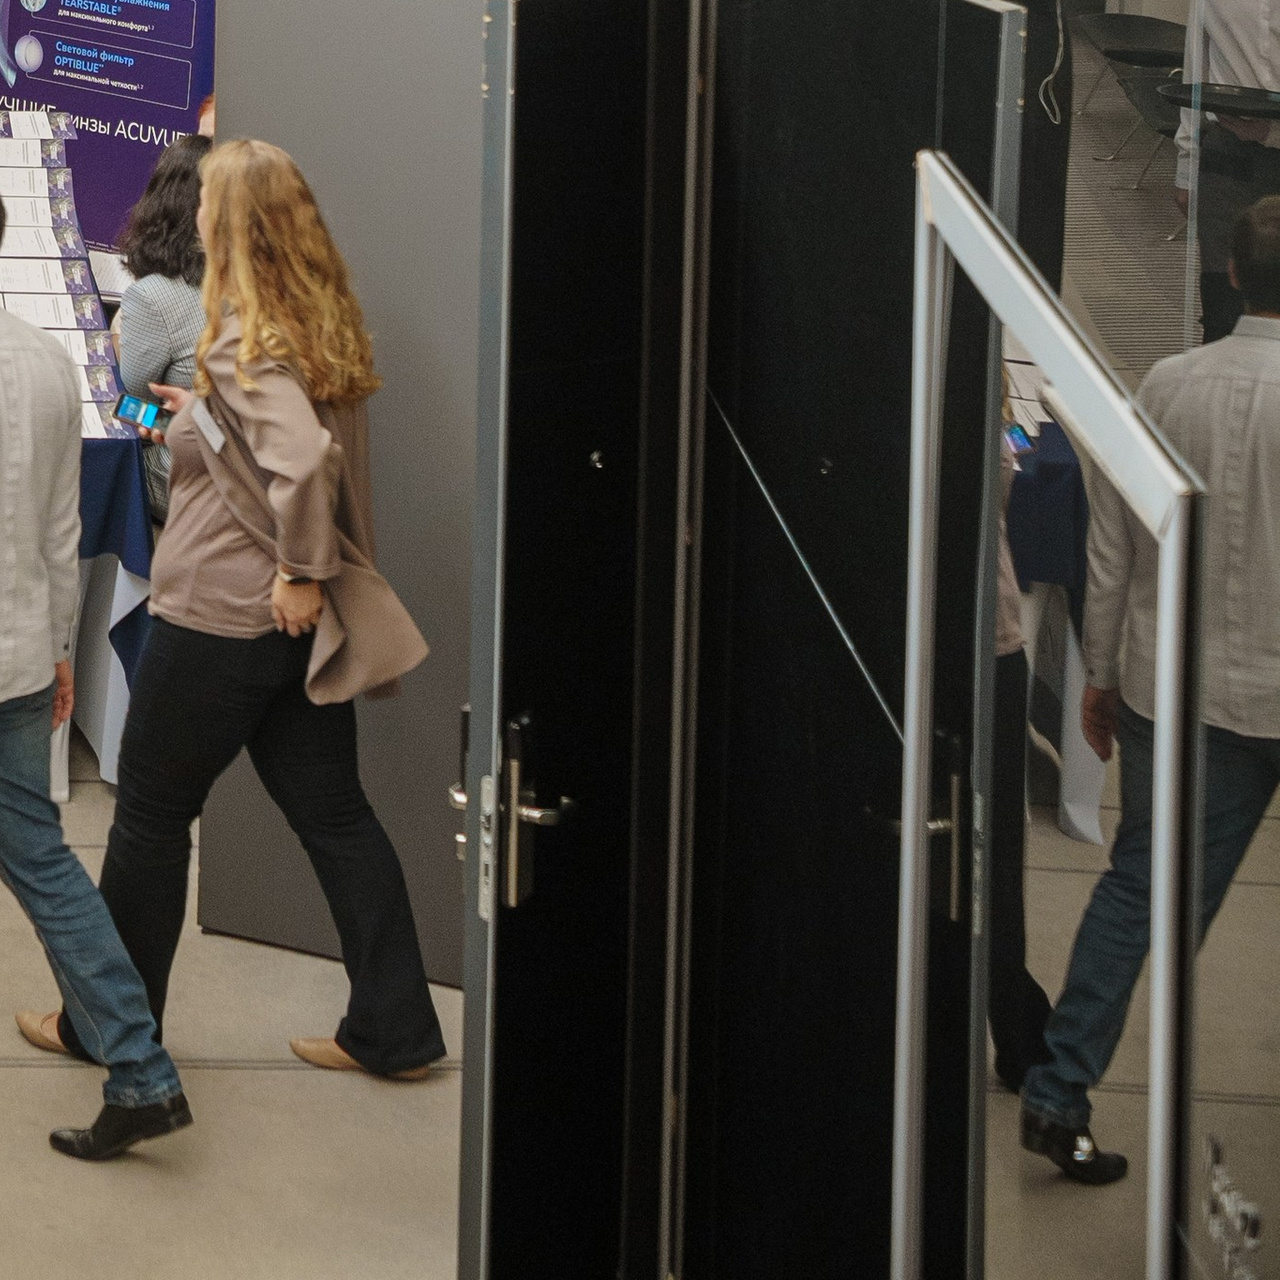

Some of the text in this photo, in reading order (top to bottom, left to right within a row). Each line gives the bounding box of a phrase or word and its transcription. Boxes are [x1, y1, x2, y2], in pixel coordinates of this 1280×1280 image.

[57, 9, 70, 17] для
[55, 41, 135, 68] Световой фильтр
[53, 69, 65, 77] для
[70, 114, 111, 136] инзы
